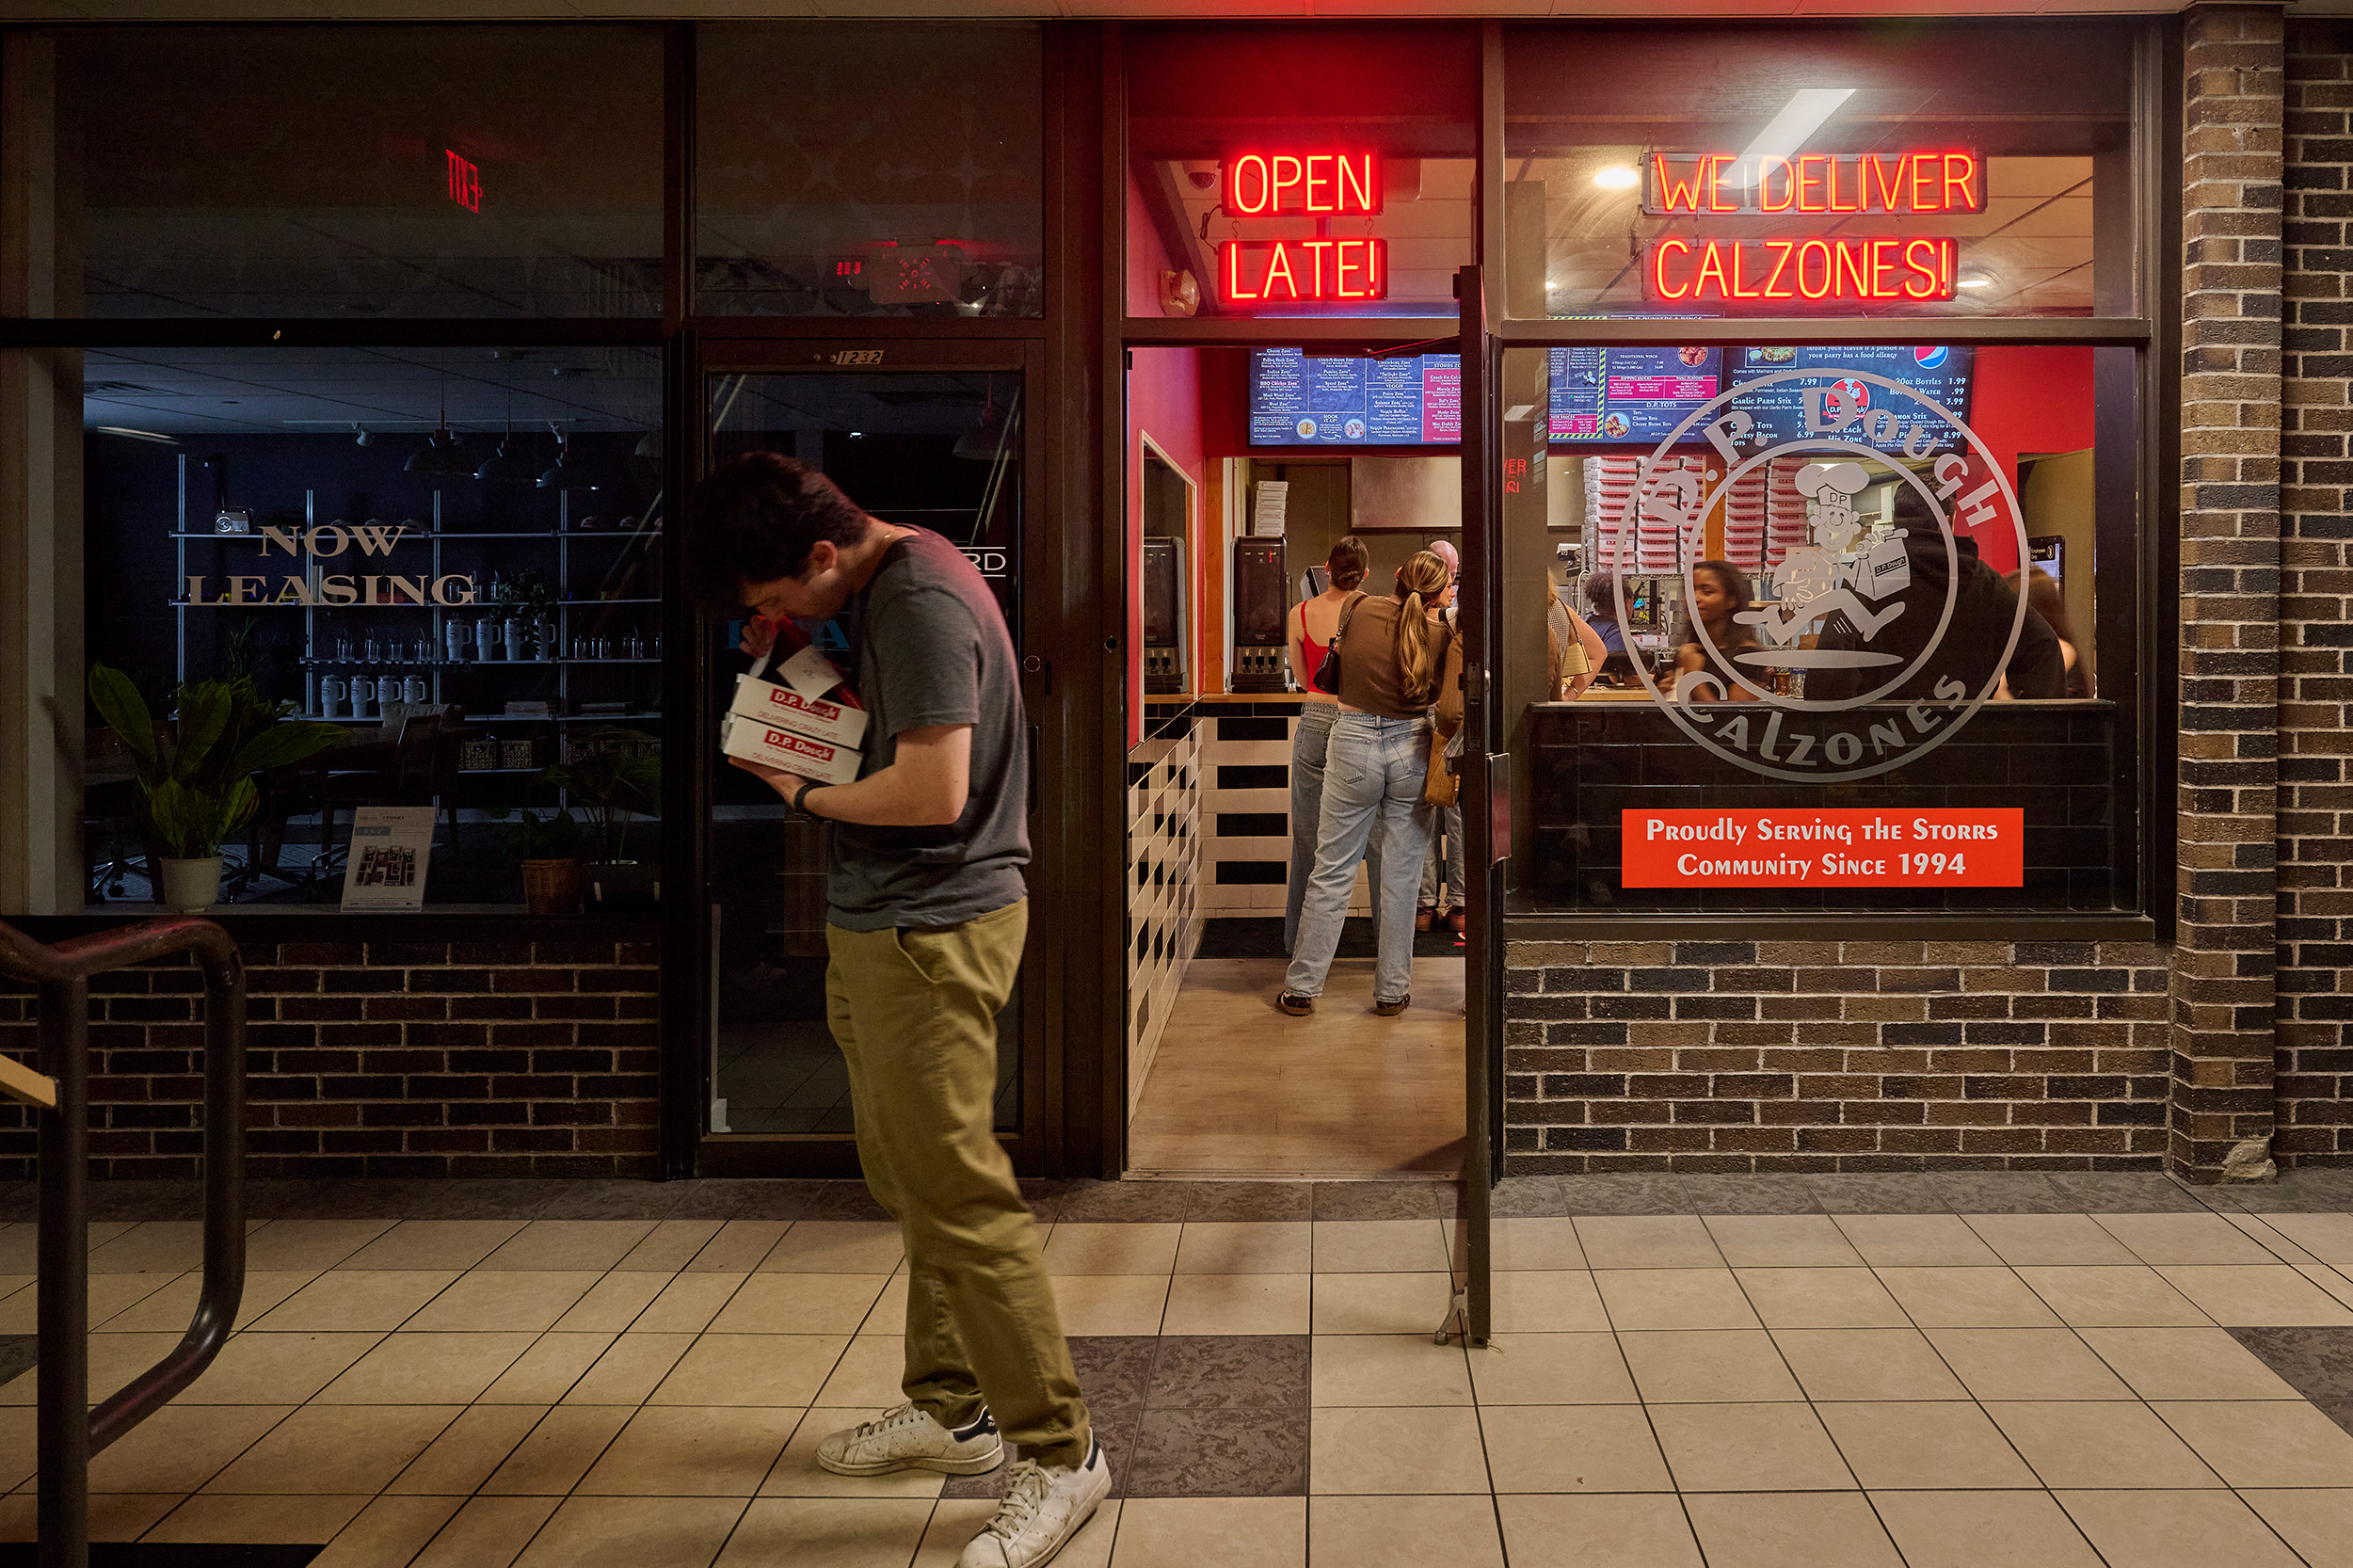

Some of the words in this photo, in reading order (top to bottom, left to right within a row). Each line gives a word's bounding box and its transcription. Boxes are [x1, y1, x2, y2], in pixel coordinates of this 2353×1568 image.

[1234, 154, 1370, 213] OPEN
[1657, 154, 1737, 211] WE
[1761, 153, 1977, 212] DELIVER
[1231, 240, 1375, 298] LATE!
[1657, 239, 1947, 298] CALZONES!
[840, 351, 881, 363] 1232
[1642, 410, 1768, 527] D.P.
[257, 525, 408, 557] NOW
[1887, 558, 1905, 568] Dough
[185, 574, 477, 607] LEASING
[774, 691, 797, 706] D.P.
[800, 700, 839, 718] Dough
[757, 711, 796, 727] DELIVERING
[797, 723, 822, 734] CRAZY
[768, 733, 791, 747] D.P.
[794, 740, 832, 759] Dough
[751, 753, 791, 768] DELIVERING
[791, 764, 815, 776] CRAZY
[1646, 817, 1748, 846] Proudly
[1757, 817, 1852, 845] Serving
[1862, 817, 1902, 840] the
[1913, 818, 1999, 840] Storrs
[1677, 852, 1812, 880] Community
[1822, 852, 1886, 875] Since
[1898, 853, 1966, 875] 1994
